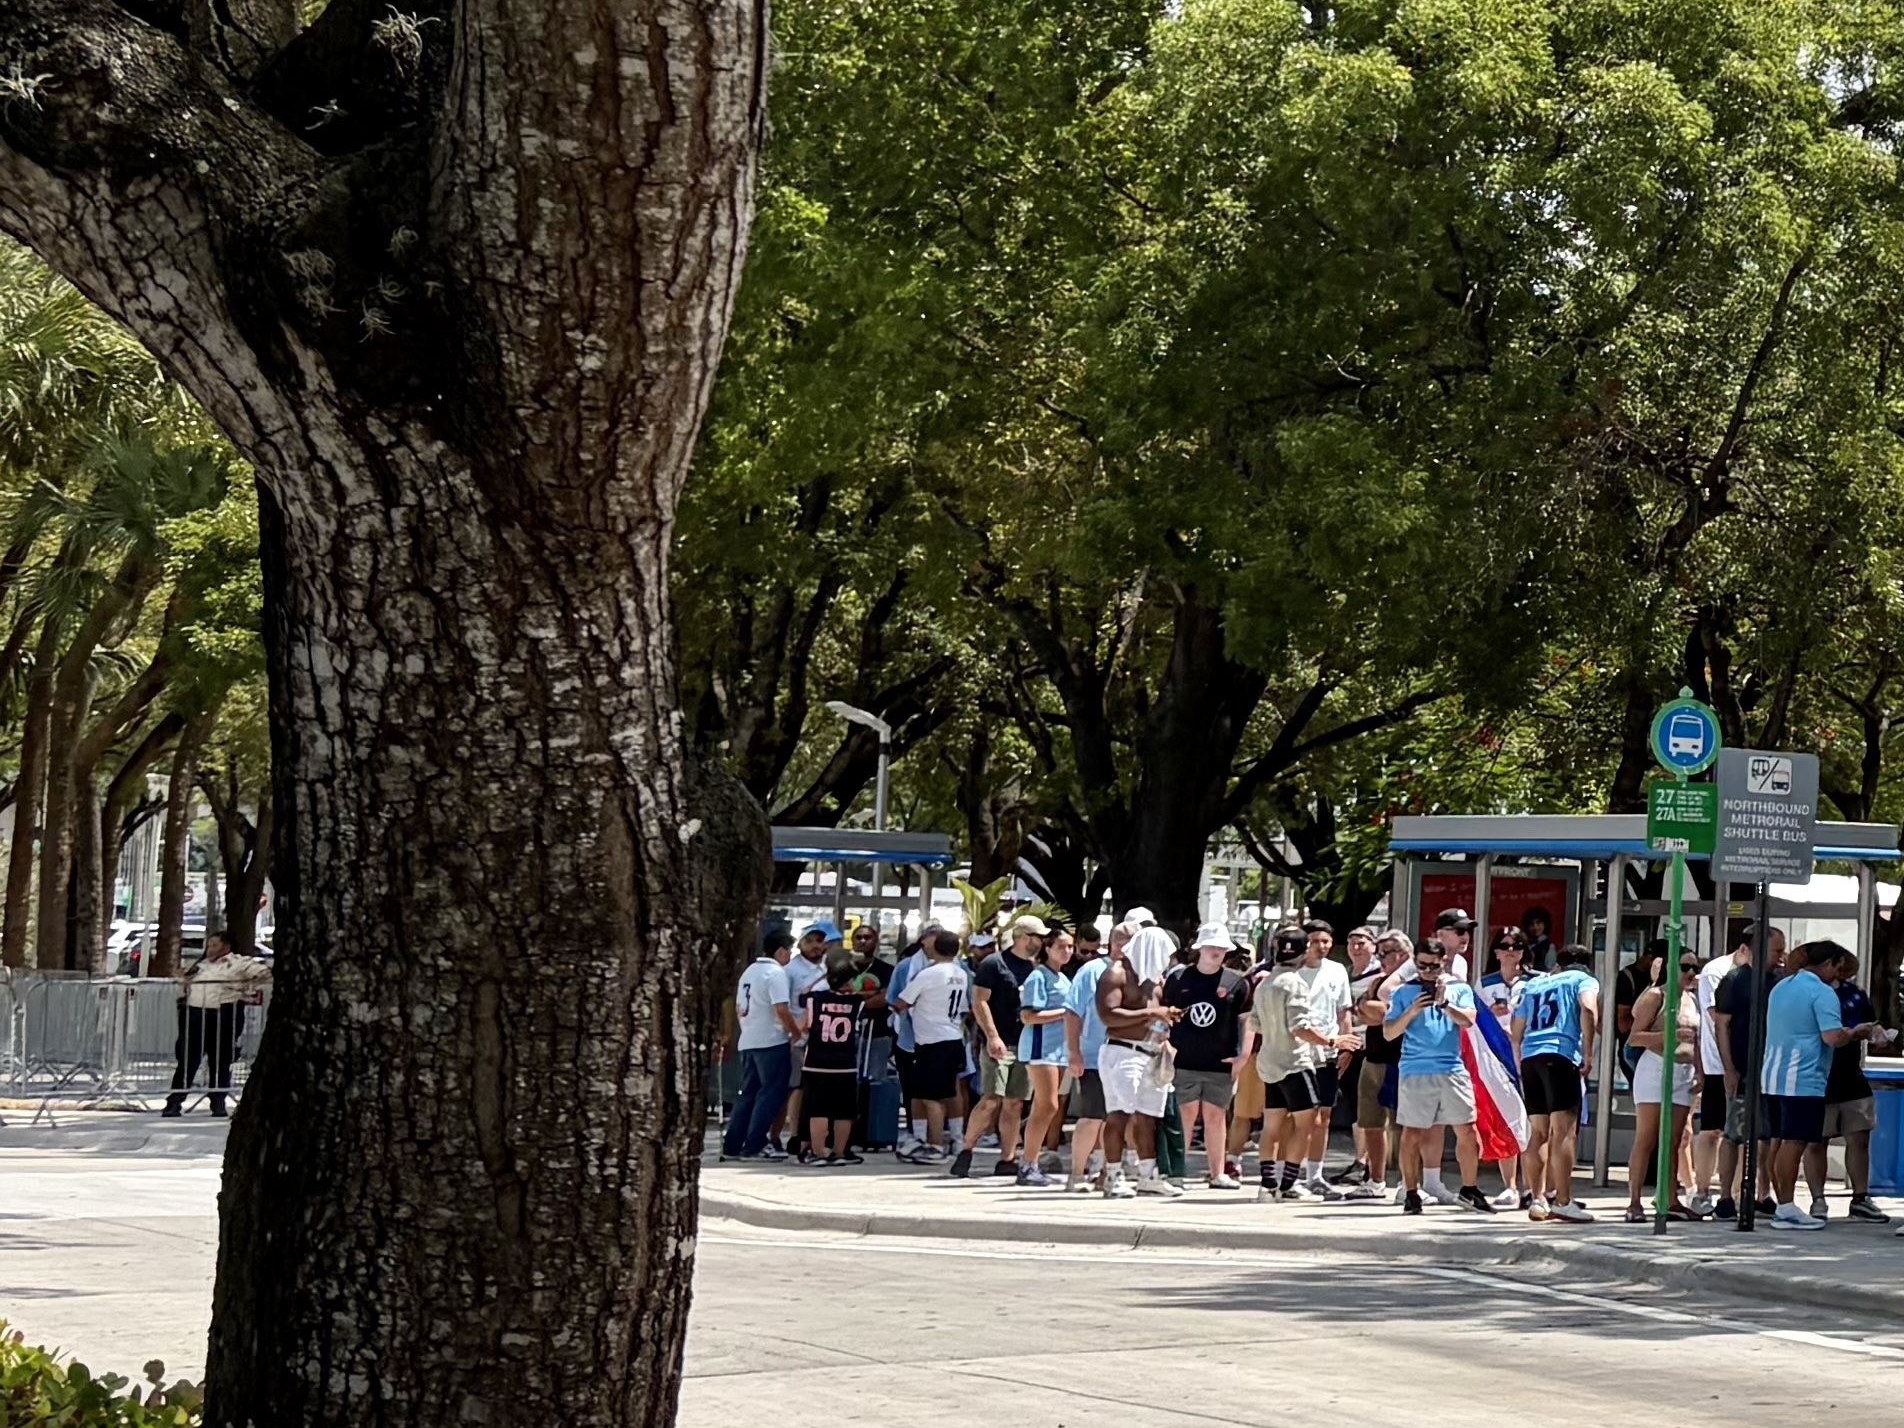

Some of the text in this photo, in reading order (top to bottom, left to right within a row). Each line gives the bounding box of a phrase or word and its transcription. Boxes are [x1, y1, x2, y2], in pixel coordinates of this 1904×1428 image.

[1656, 788, 1676, 804] 27
[1655, 806, 1676, 821] 27A
[1723, 799, 1810, 816] NORTHBOUND
[1731, 813, 1801, 829] METRORAIL
[1723, 826, 1808, 843] SHUTTLE BUS
[1531, 987, 1559, 1031] 15
[818, 1013, 852, 1043] 10
